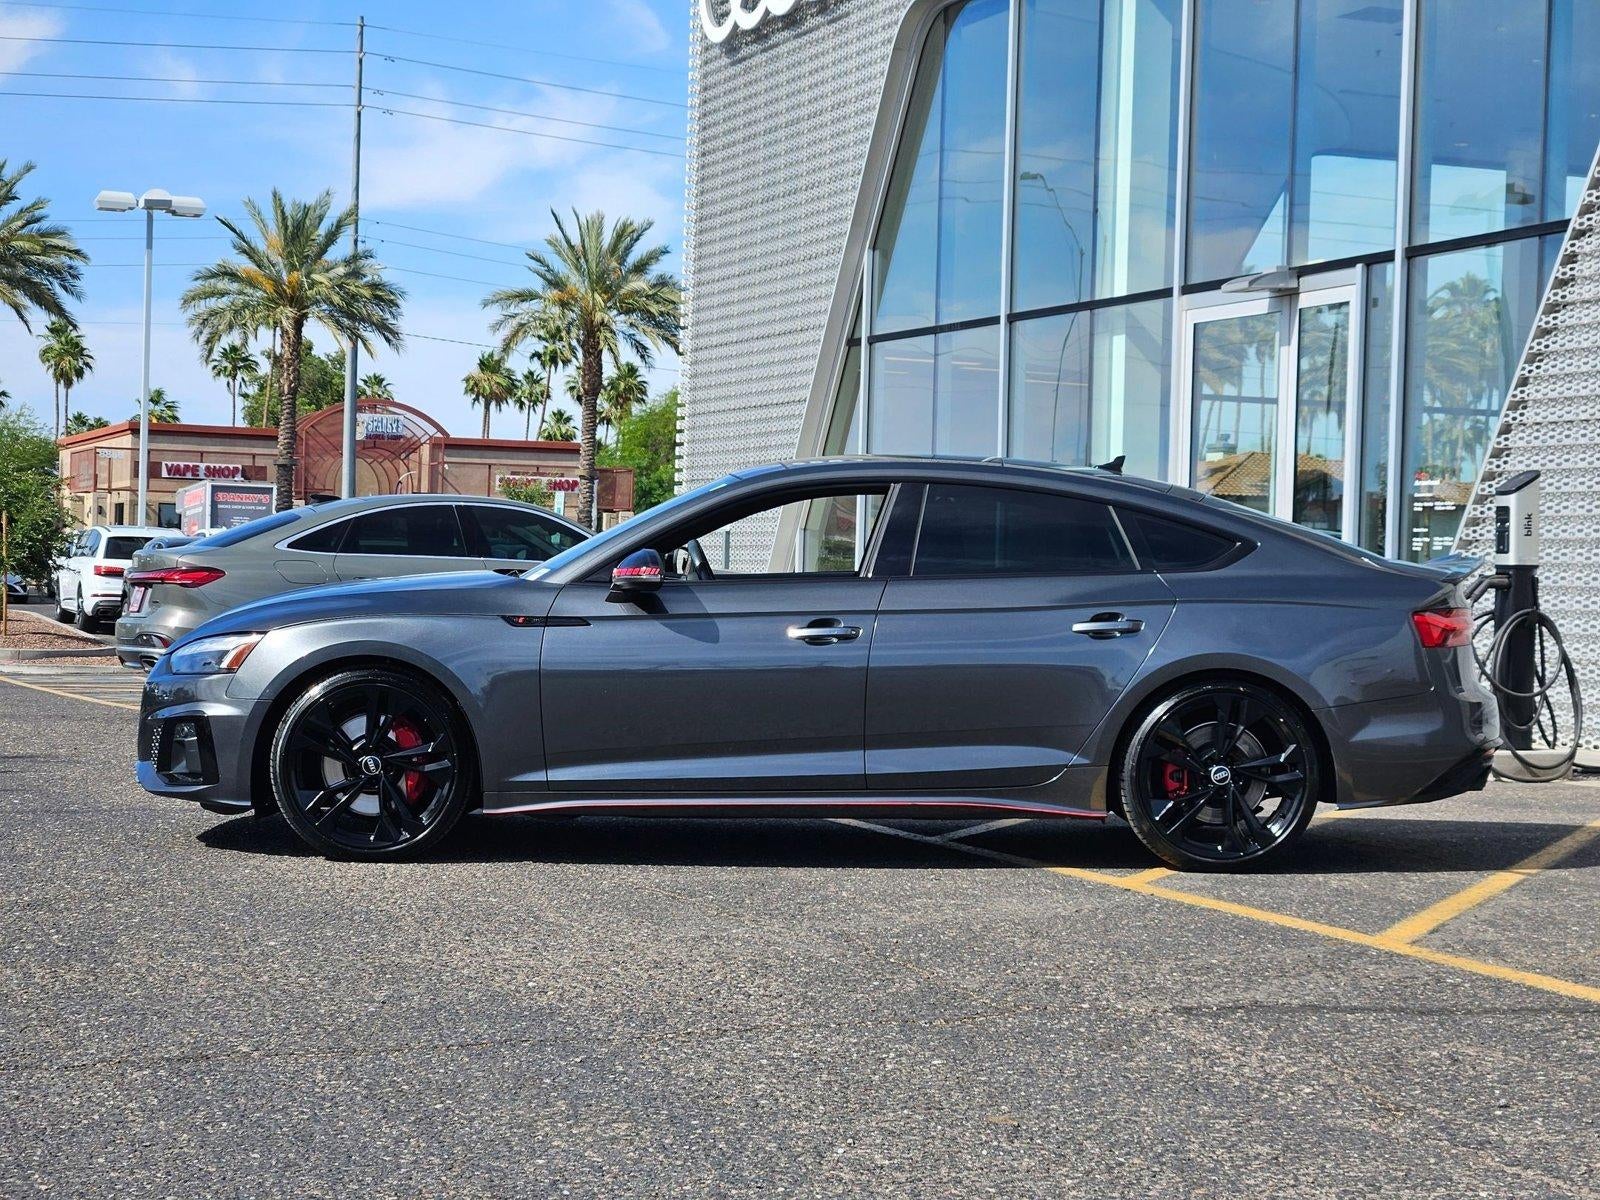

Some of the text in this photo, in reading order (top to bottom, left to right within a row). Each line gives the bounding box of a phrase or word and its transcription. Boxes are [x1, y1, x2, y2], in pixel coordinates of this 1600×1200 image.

[165, 463, 240, 478] VAPE SHOP
[215, 492, 270, 504] SPANKY'S
[1524, 513, 1533, 536] blink
